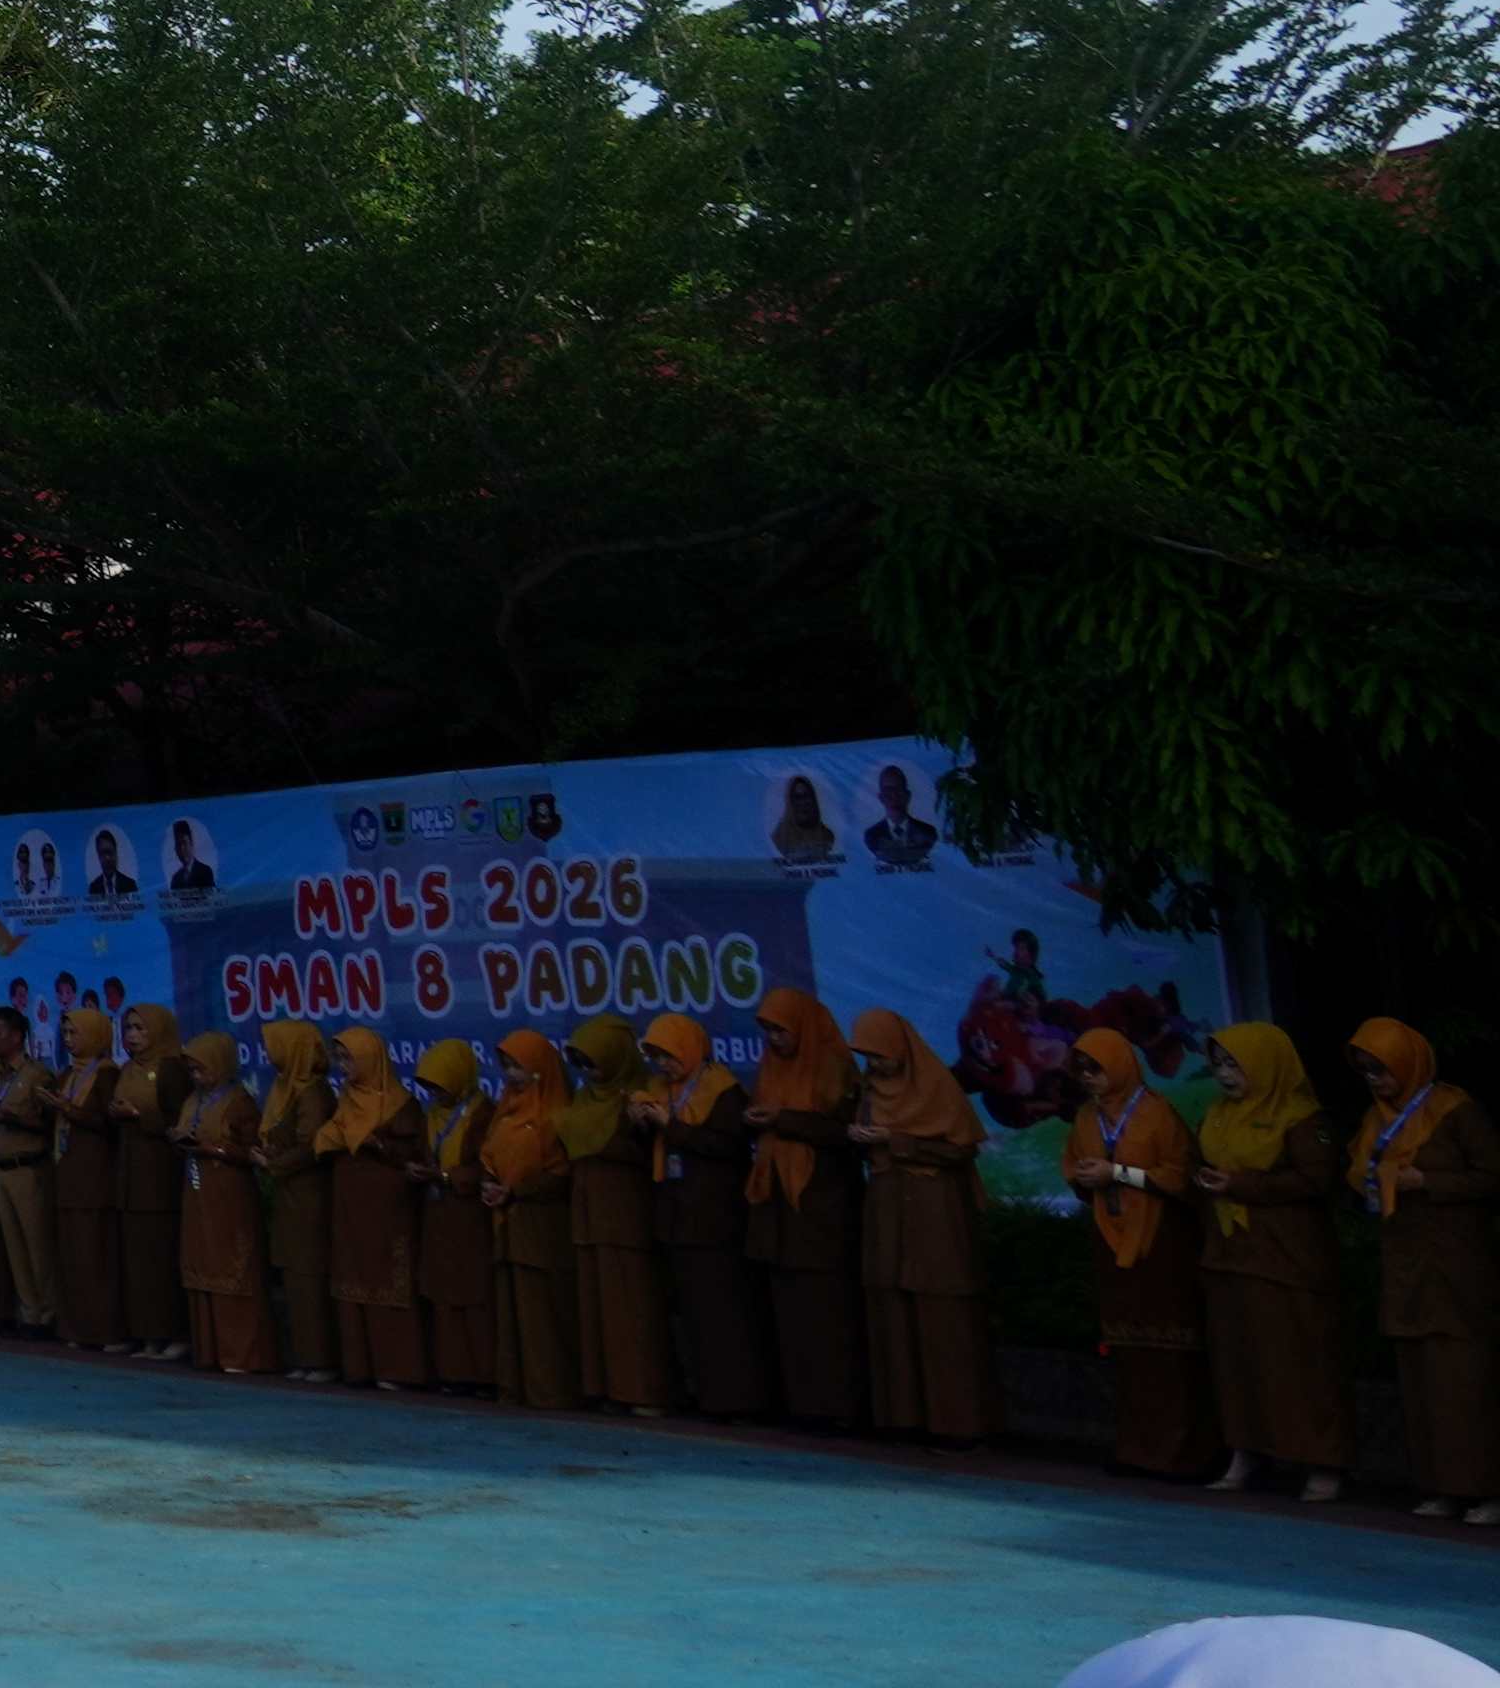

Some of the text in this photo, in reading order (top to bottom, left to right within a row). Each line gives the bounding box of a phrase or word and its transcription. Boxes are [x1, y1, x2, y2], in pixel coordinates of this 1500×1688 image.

[294, 865, 451, 940] MPLS
[482, 853, 647, 928] 2026
[222, 932, 763, 1024] SMAN 8 PADANG
